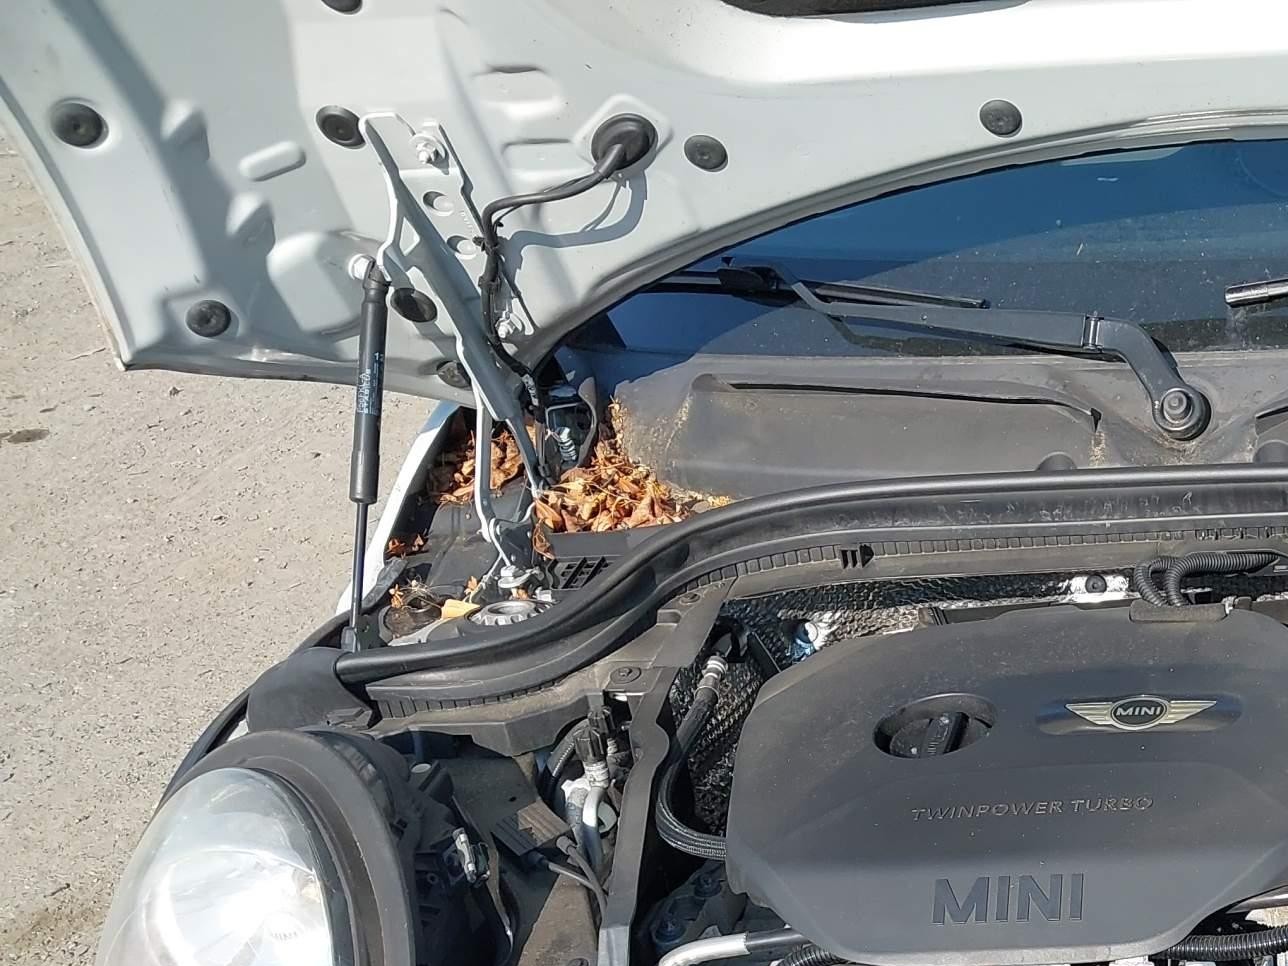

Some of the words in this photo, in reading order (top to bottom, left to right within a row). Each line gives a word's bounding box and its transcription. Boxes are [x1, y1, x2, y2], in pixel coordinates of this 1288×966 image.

[1115, 705, 1162, 717] MINI
[910, 799, 1064, 821] TWINPOWER
[1071, 796, 1154, 813] TURBO
[931, 872, 1085, 926] MINI
